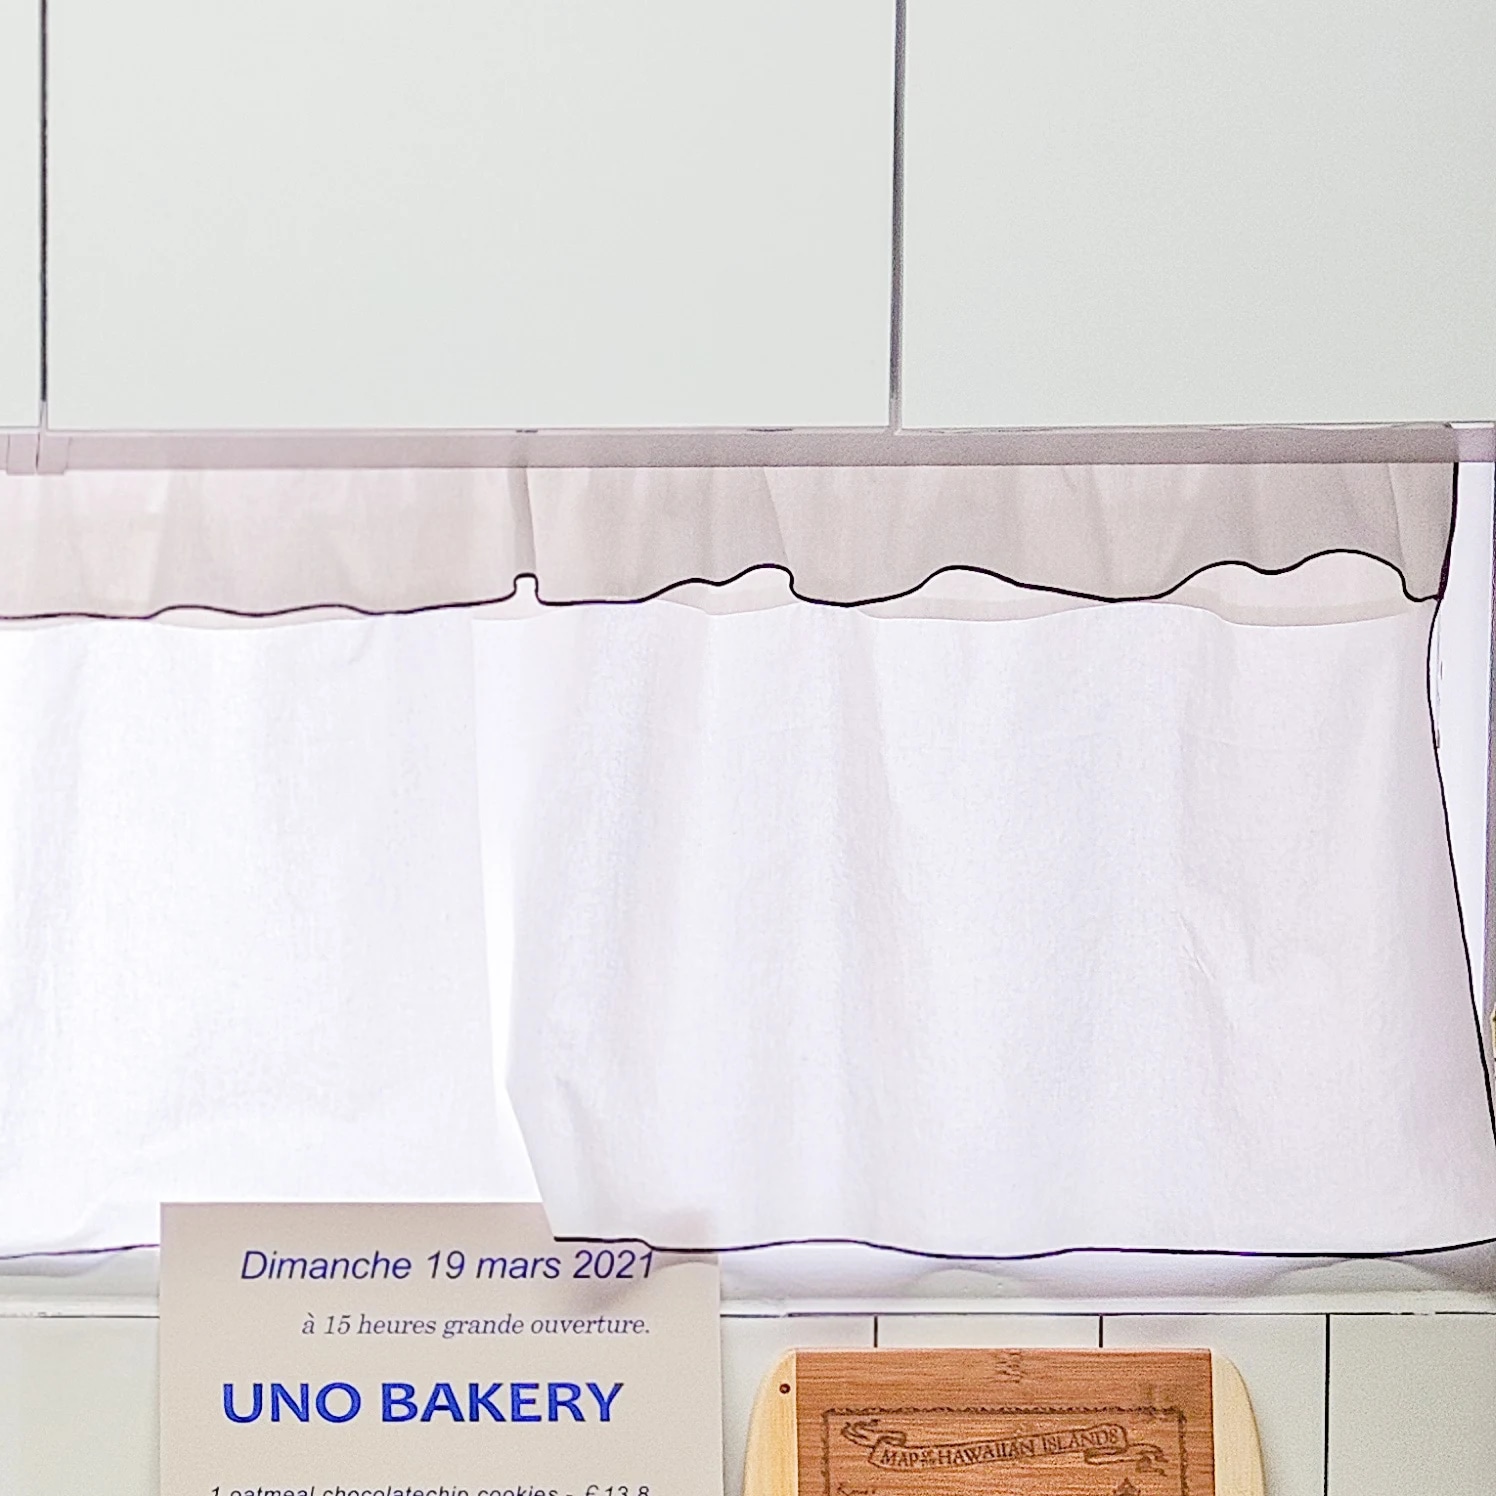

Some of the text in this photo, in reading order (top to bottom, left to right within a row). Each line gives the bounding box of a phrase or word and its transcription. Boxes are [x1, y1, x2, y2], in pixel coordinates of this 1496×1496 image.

[240, 1249, 653, 1281] Dimanche 19 mars 2021
[301, 1311, 650, 1340] à 15 heures grande ouverture.
[221, 1381, 625, 1424] UNO BAKERY
[937, 1439, 1035, 1466] HAWAIIAN
[1042, 1427, 1119, 1451] ISLANDS
